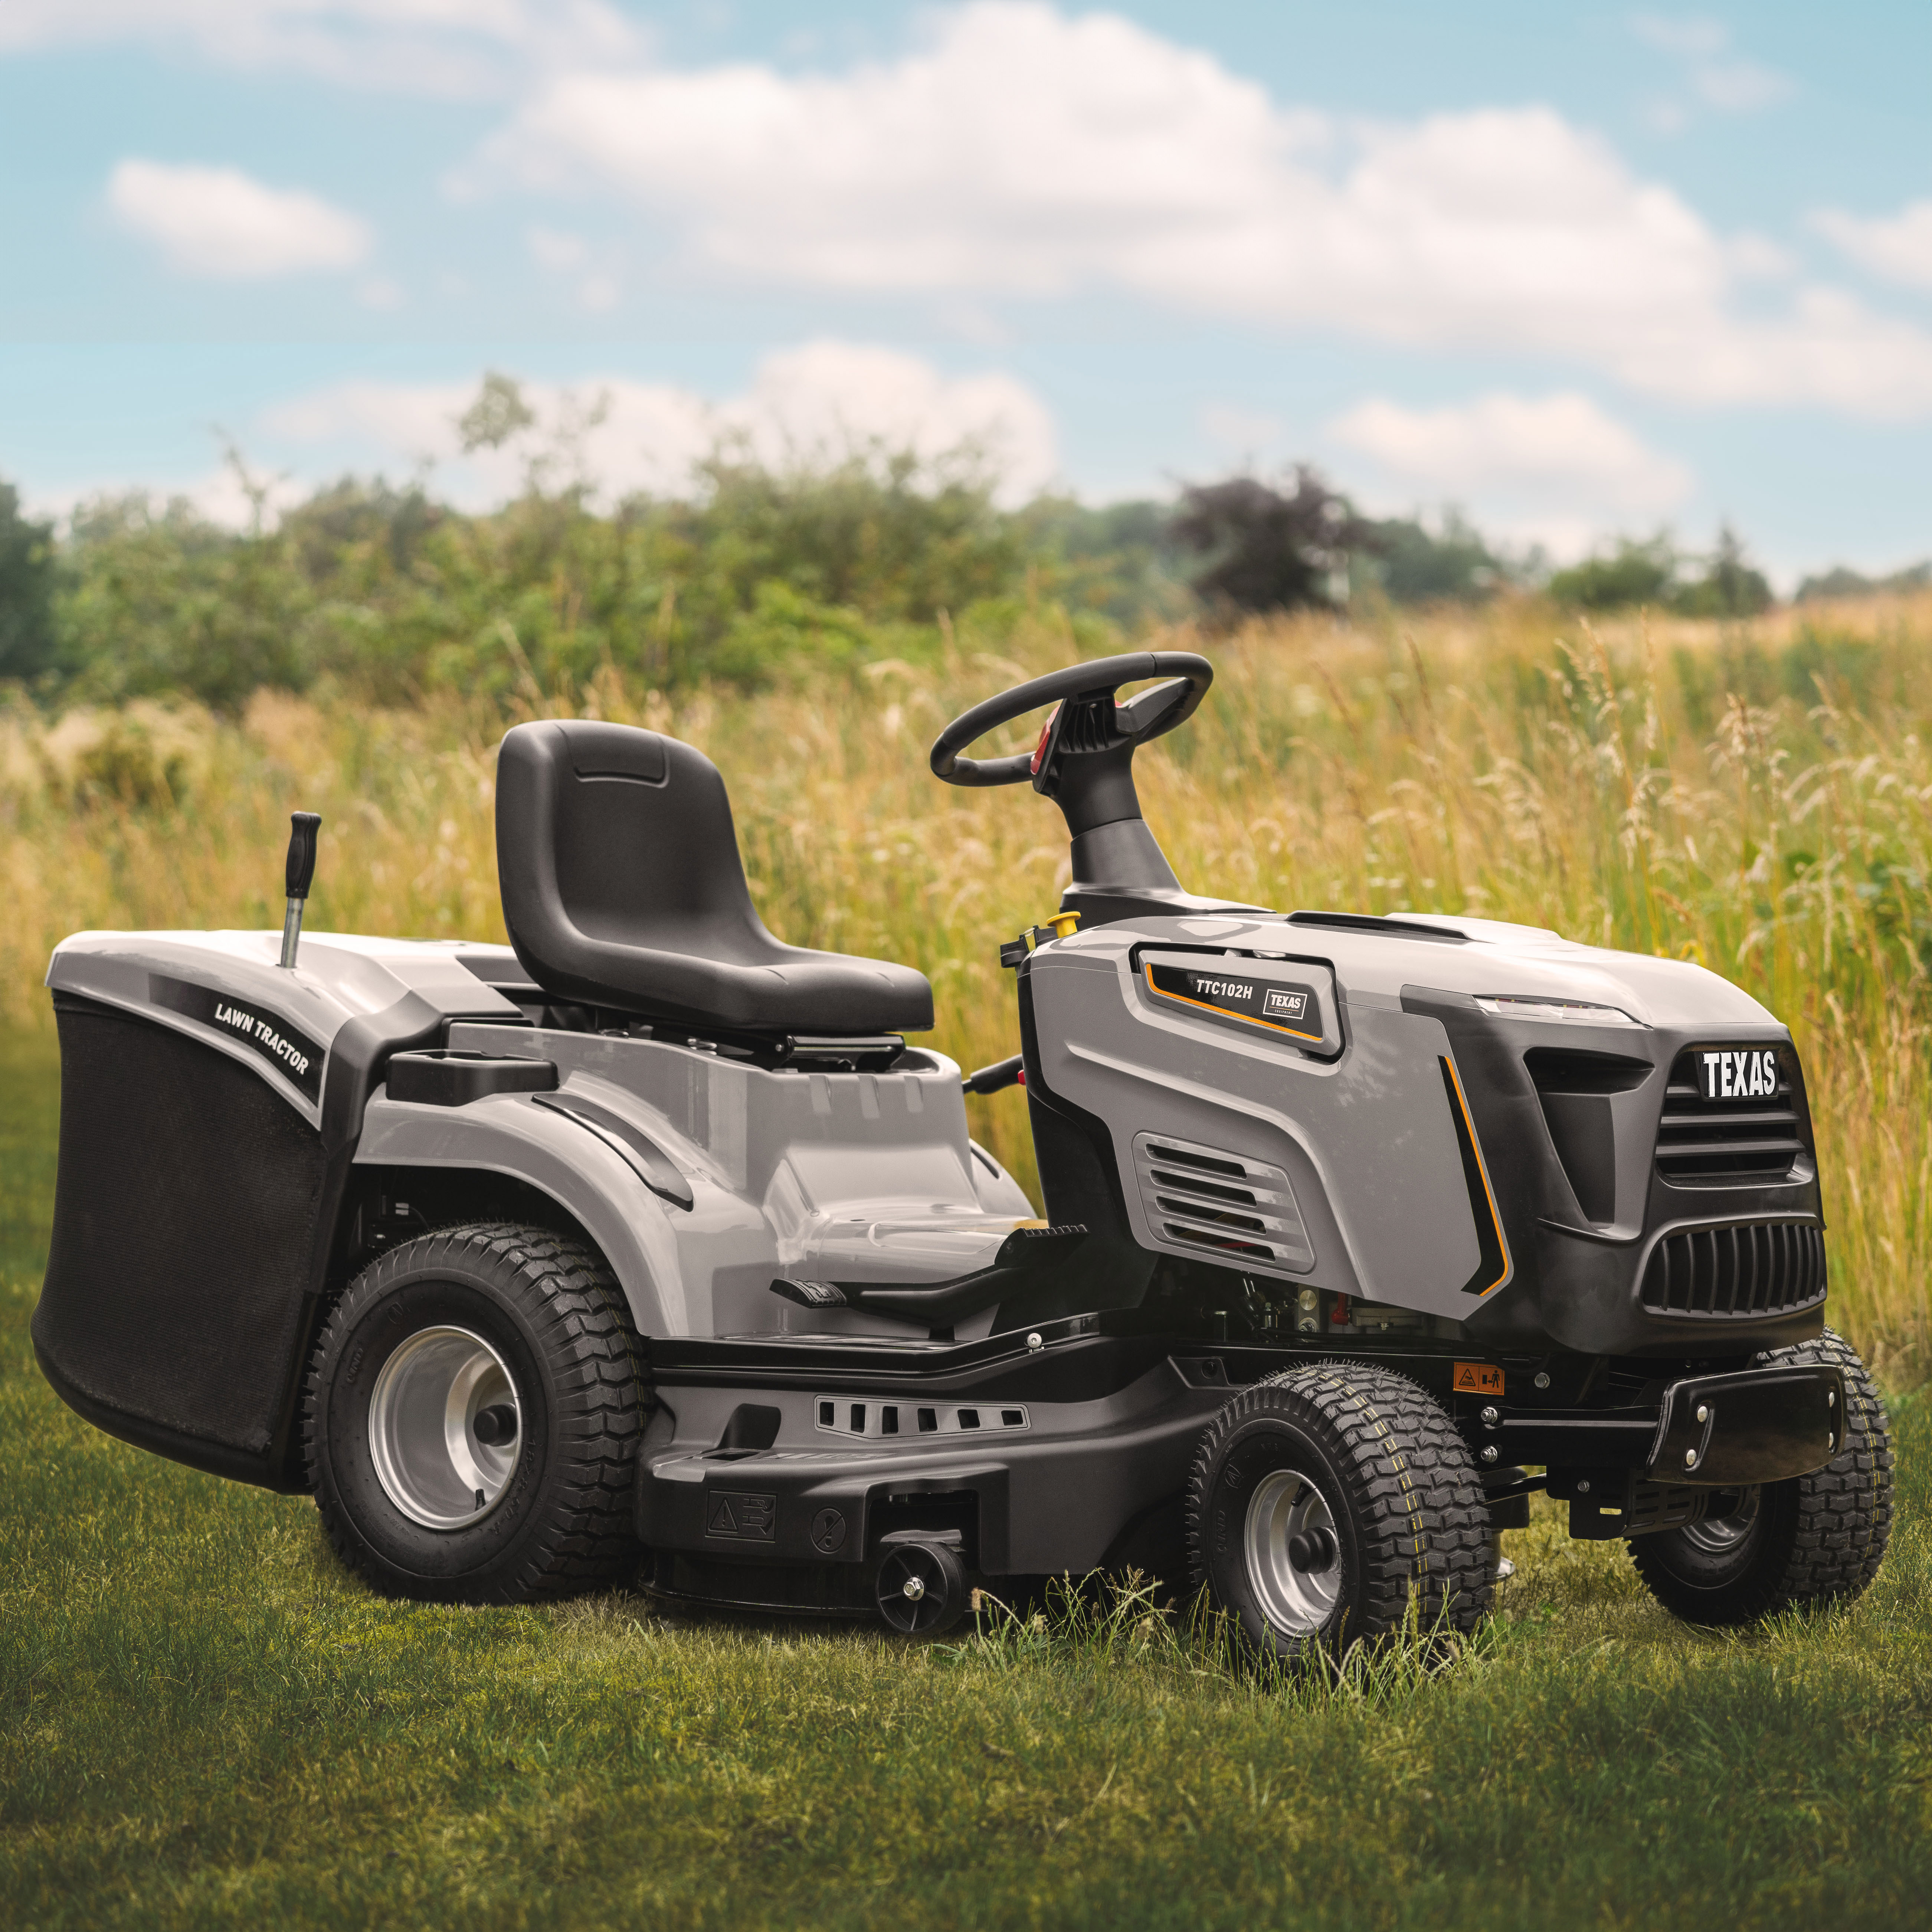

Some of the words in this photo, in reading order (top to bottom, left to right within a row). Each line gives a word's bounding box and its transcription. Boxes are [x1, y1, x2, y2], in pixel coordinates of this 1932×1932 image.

[1196, 979, 1253, 999] TTC102H
[1271, 994, 1301, 1009] TEXAS
[214, 1003, 255, 1032] LAWN
[254, 1020, 309, 1075] TRACTOR
[1703, 1051, 1775, 1097] TEXAS
